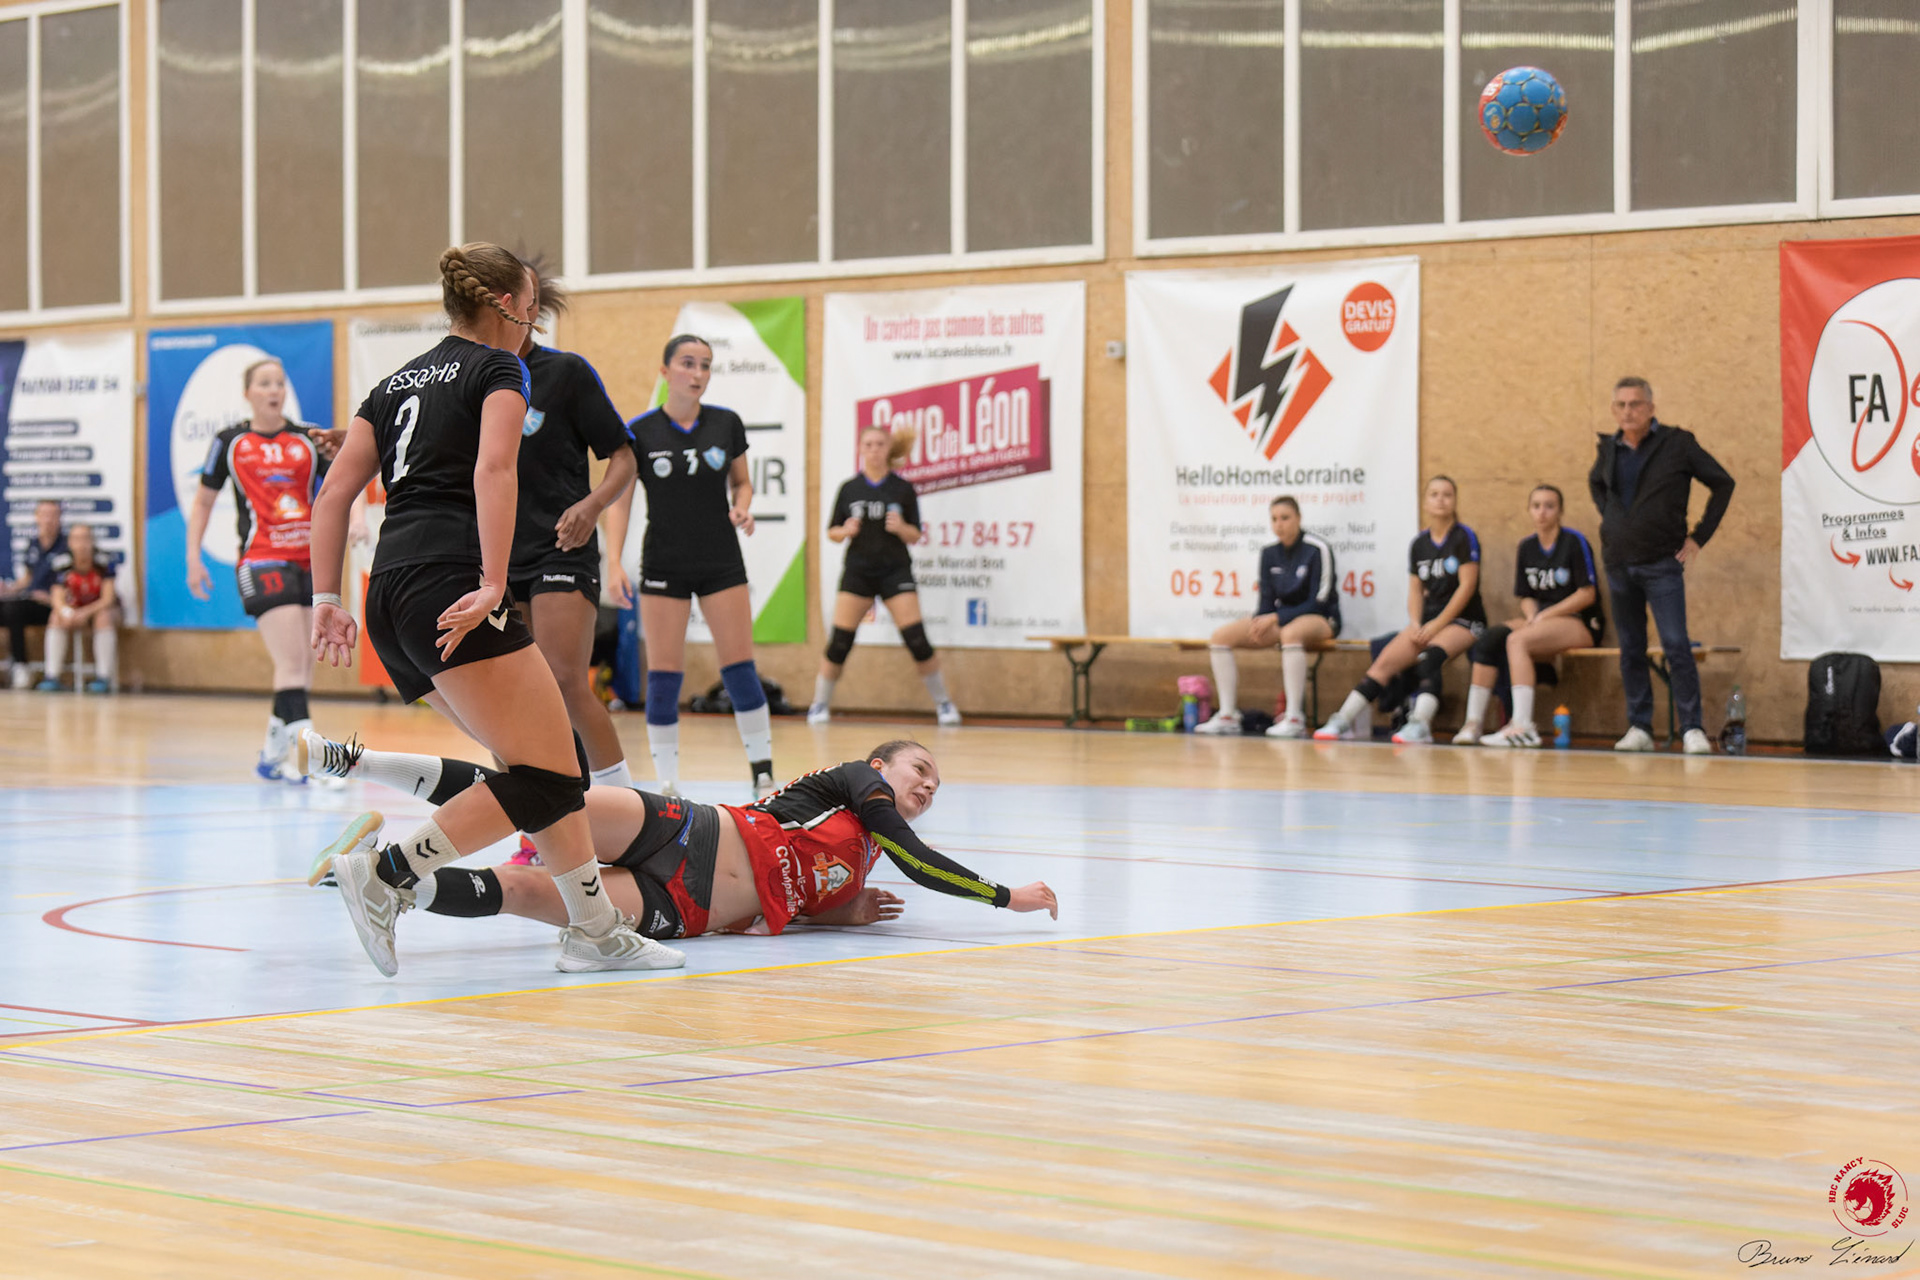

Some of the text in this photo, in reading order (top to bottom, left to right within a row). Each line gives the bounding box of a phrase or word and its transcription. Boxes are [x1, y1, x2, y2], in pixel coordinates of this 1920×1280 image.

[1345, 299, 1393, 319] DEVIS
[945, 316, 985, 338] comme
[988, 310, 1005, 335] les
[1009, 310, 1045, 335] autres
[1345, 318, 1392, 334] GRATUIT
[942, 422, 959, 459] de
[959, 376, 1031, 456] Léon
[390, 394, 421, 483] 2
[1176, 464, 1365, 486] HelloHomeLorraine
[1193, 492, 1247, 505] solution
[1323, 491, 1365, 506] projet
[1348, 522, 1376, 534] Neuf
[1822, 510, 1905, 527] Programmes
[939, 522, 965, 547] 17
[972, 521, 1001, 547] 84
[1007, 521, 1035, 547] 57
[1842, 524, 1887, 540] & Infos
[543, 573, 575, 584] hummel
[951, 575, 991, 589] NANCY
[1171, 569, 1375, 598] 06 21 46
[649, 909, 660, 934] SELECT
